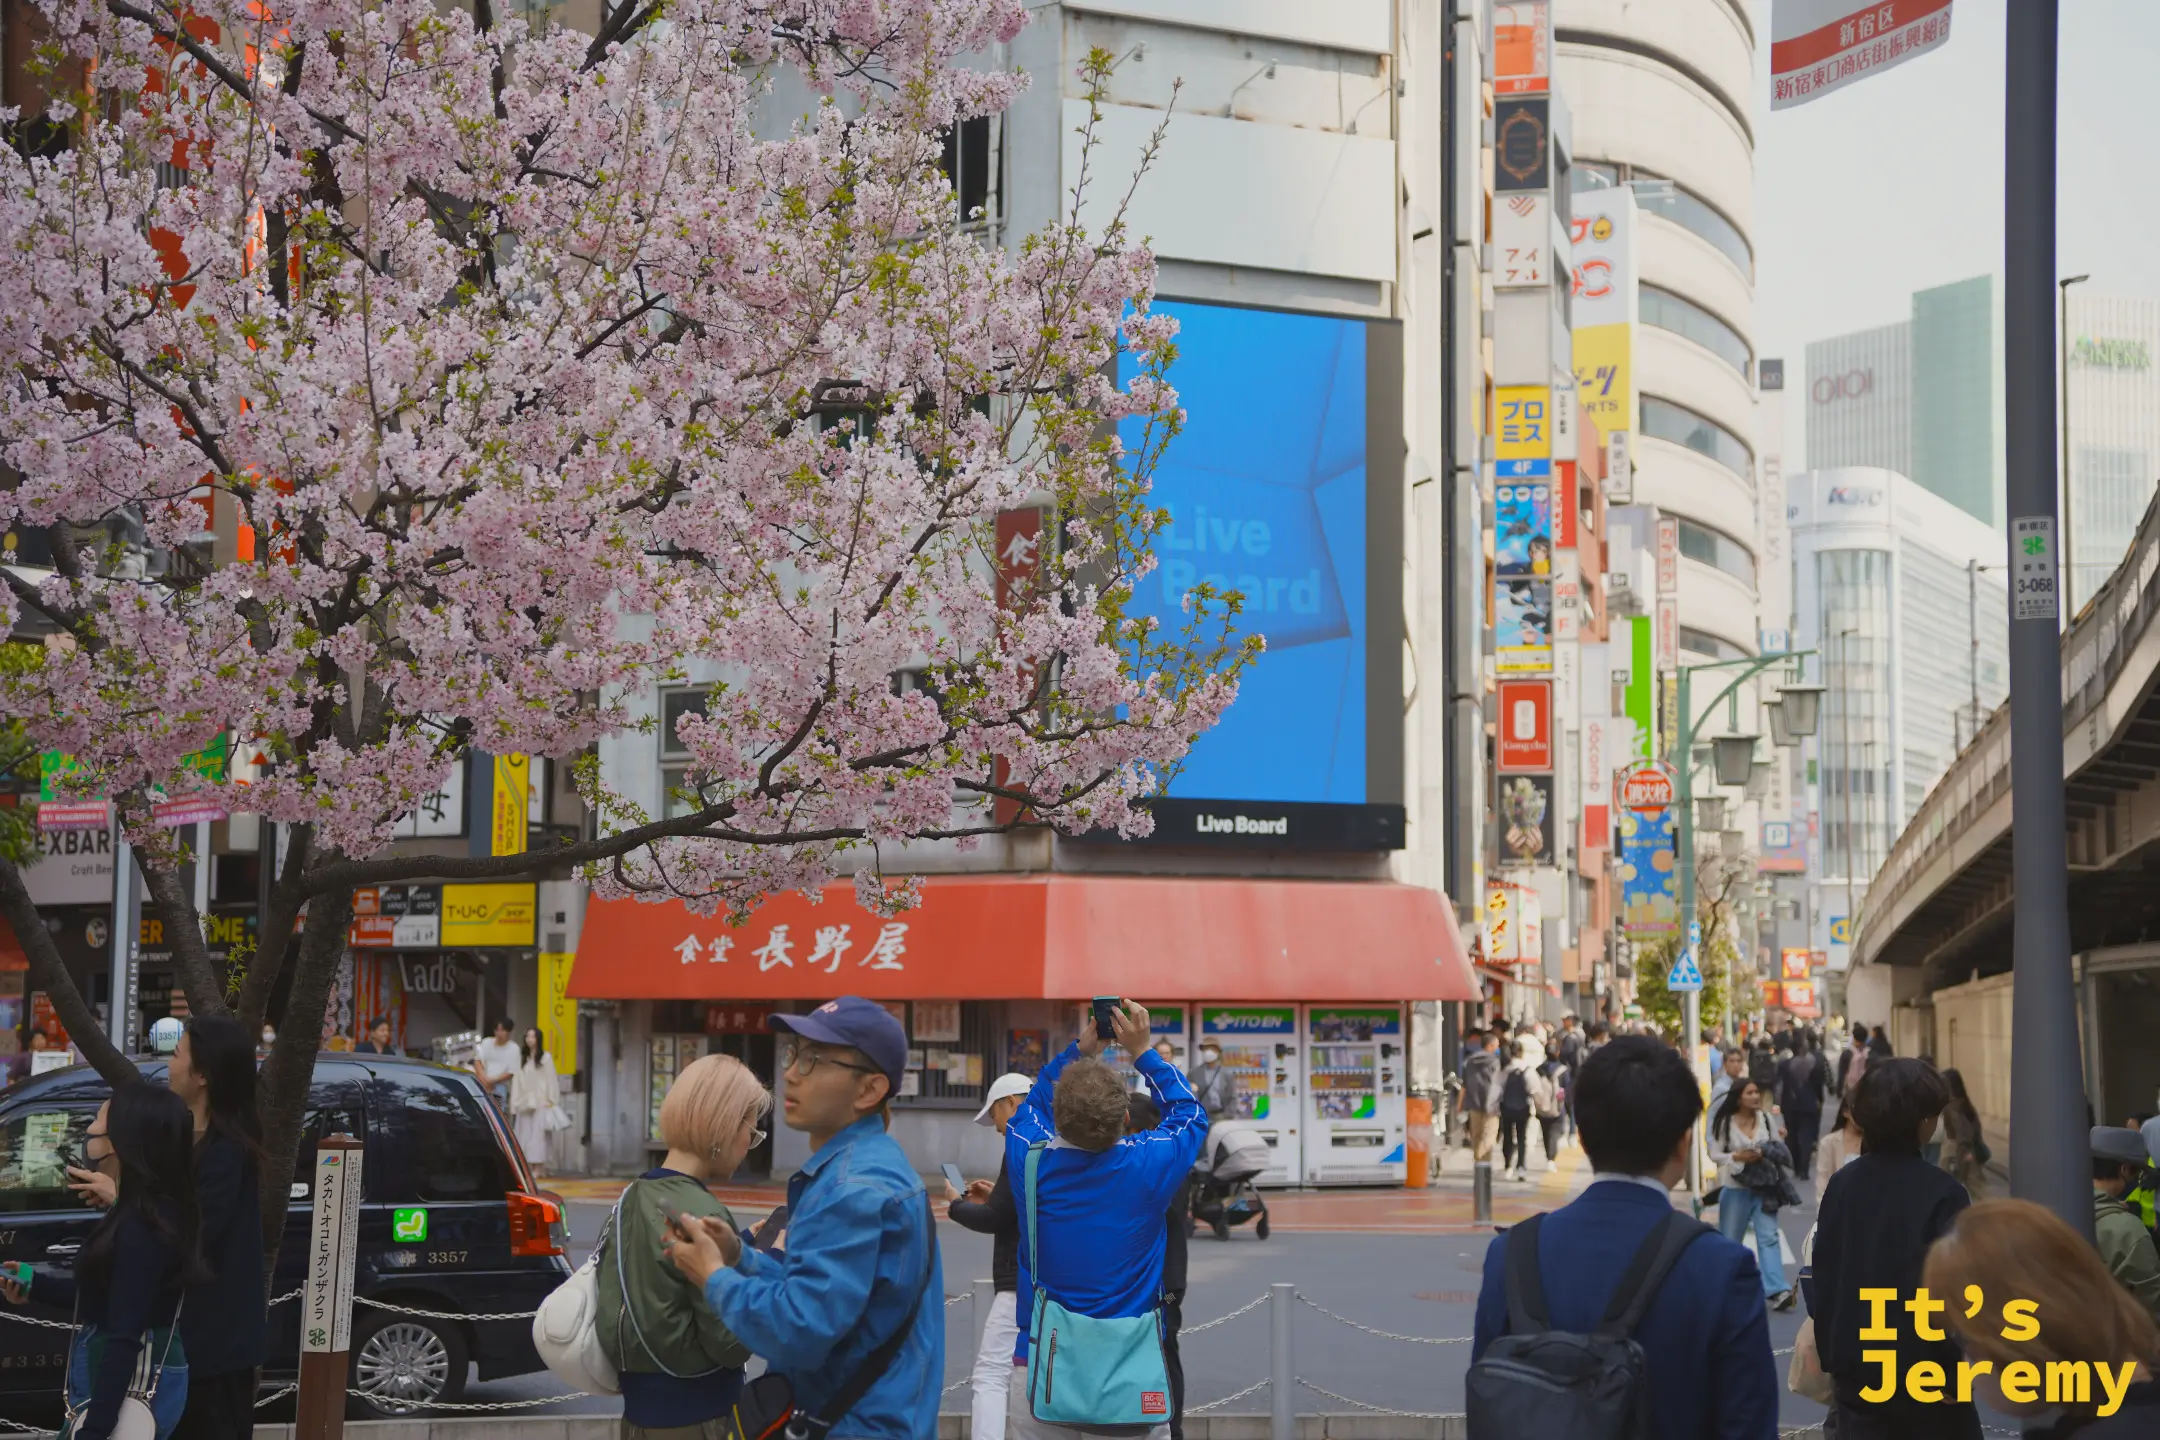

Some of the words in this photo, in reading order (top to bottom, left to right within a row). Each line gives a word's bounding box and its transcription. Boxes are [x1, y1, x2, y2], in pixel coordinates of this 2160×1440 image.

[1839, 4, 1894, 47] 新宿区
[1774, 11, 1950, 100] 新宿東口商店街振興組合
[1505, 248, 1538, 262] アイ
[1505, 269, 1539, 282] フル
[1502, 398, 1543, 420] プロ
[1502, 424, 1543, 443] ミス
[1512, 461, 1532, 474] 4F
[1163, 502, 1271, 556] Live
[2019, 522, 2048, 531] 新宿区
[1163, 558, 1321, 614] Board
[2019, 579, 2053, 593] 3-068
[1589, 723, 1602, 792] docomo
[1197, 814, 1234, 833] Live
[1235, 815, 1288, 834] Board
[71, 864, 93, 876] Craft
[95, 864, 112, 875] Bee
[674, 934, 735, 964] 食堂
[751, 922, 909, 973] 長野屋
[1233, 1013, 1260, 1027] ITO
[1261, 1013, 1283, 1027] EN
[158, 1032, 177, 1041] 3357
[314, 1174, 334, 1320] タカトオコヒガンザクラ
[427, 1251, 469, 1264] 3357
